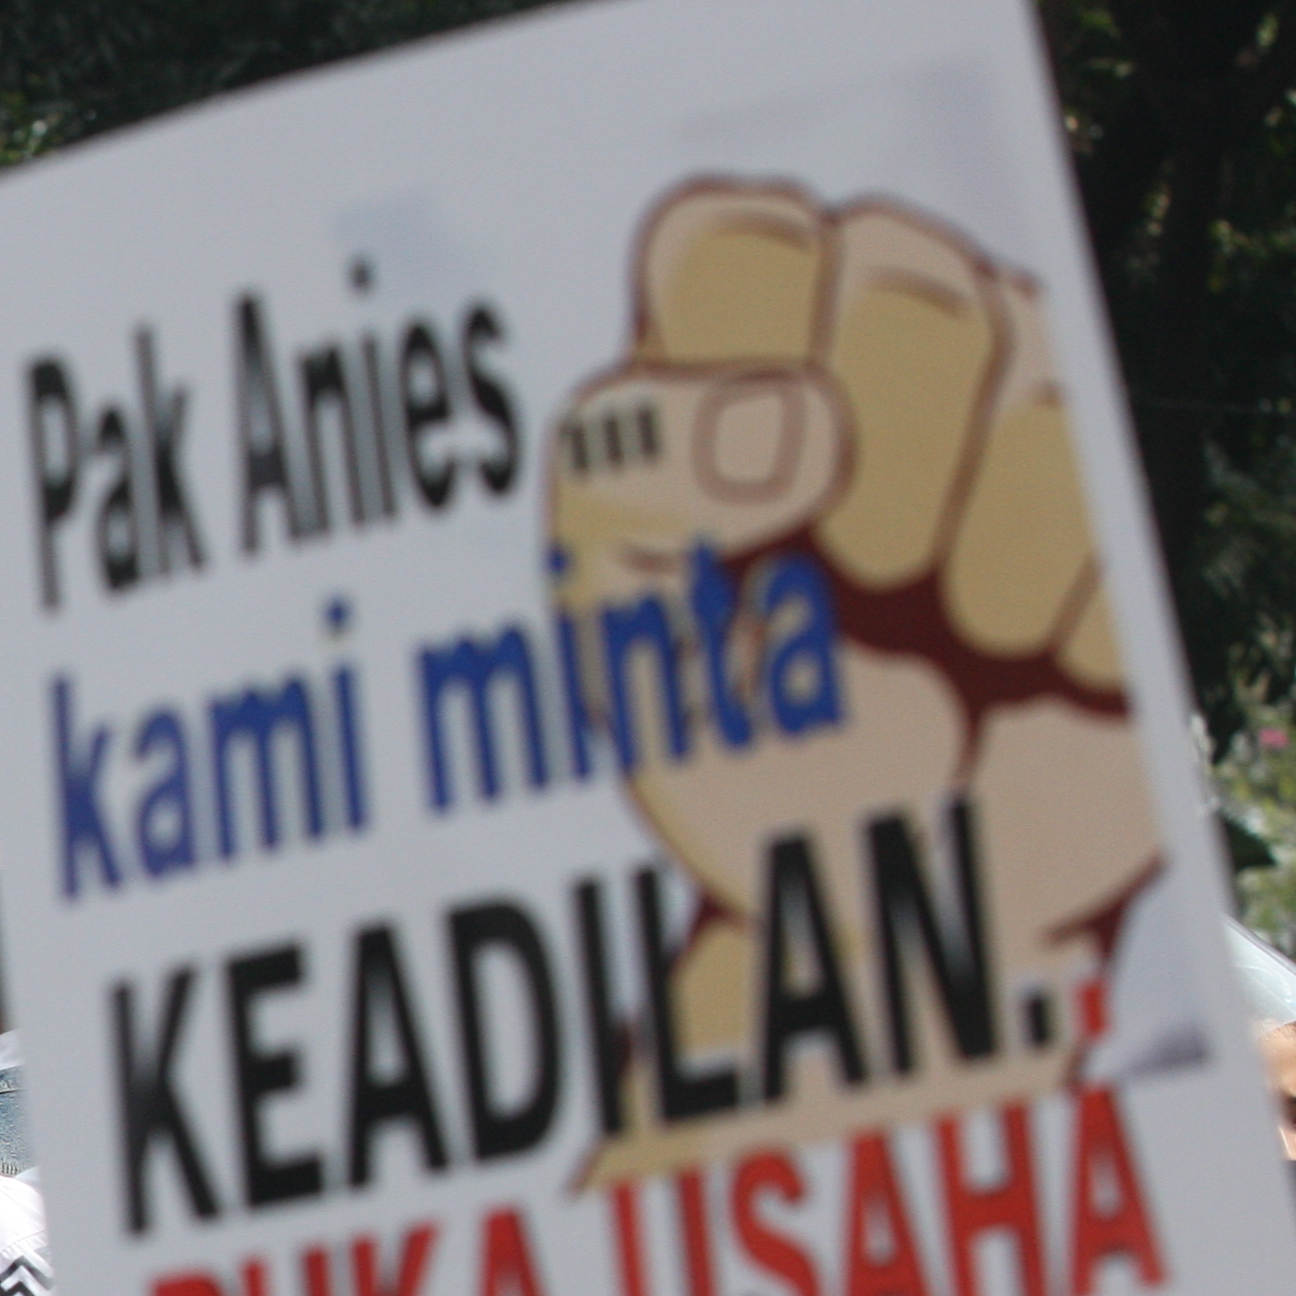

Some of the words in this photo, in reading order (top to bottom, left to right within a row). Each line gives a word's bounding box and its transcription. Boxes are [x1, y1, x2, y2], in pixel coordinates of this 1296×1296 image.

[25, 325, 208, 610] Pak
[54, 596, 372, 902] kami
[417, 534, 846, 808] minta
[114, 797, 1050, 1236] KEADILAN.
